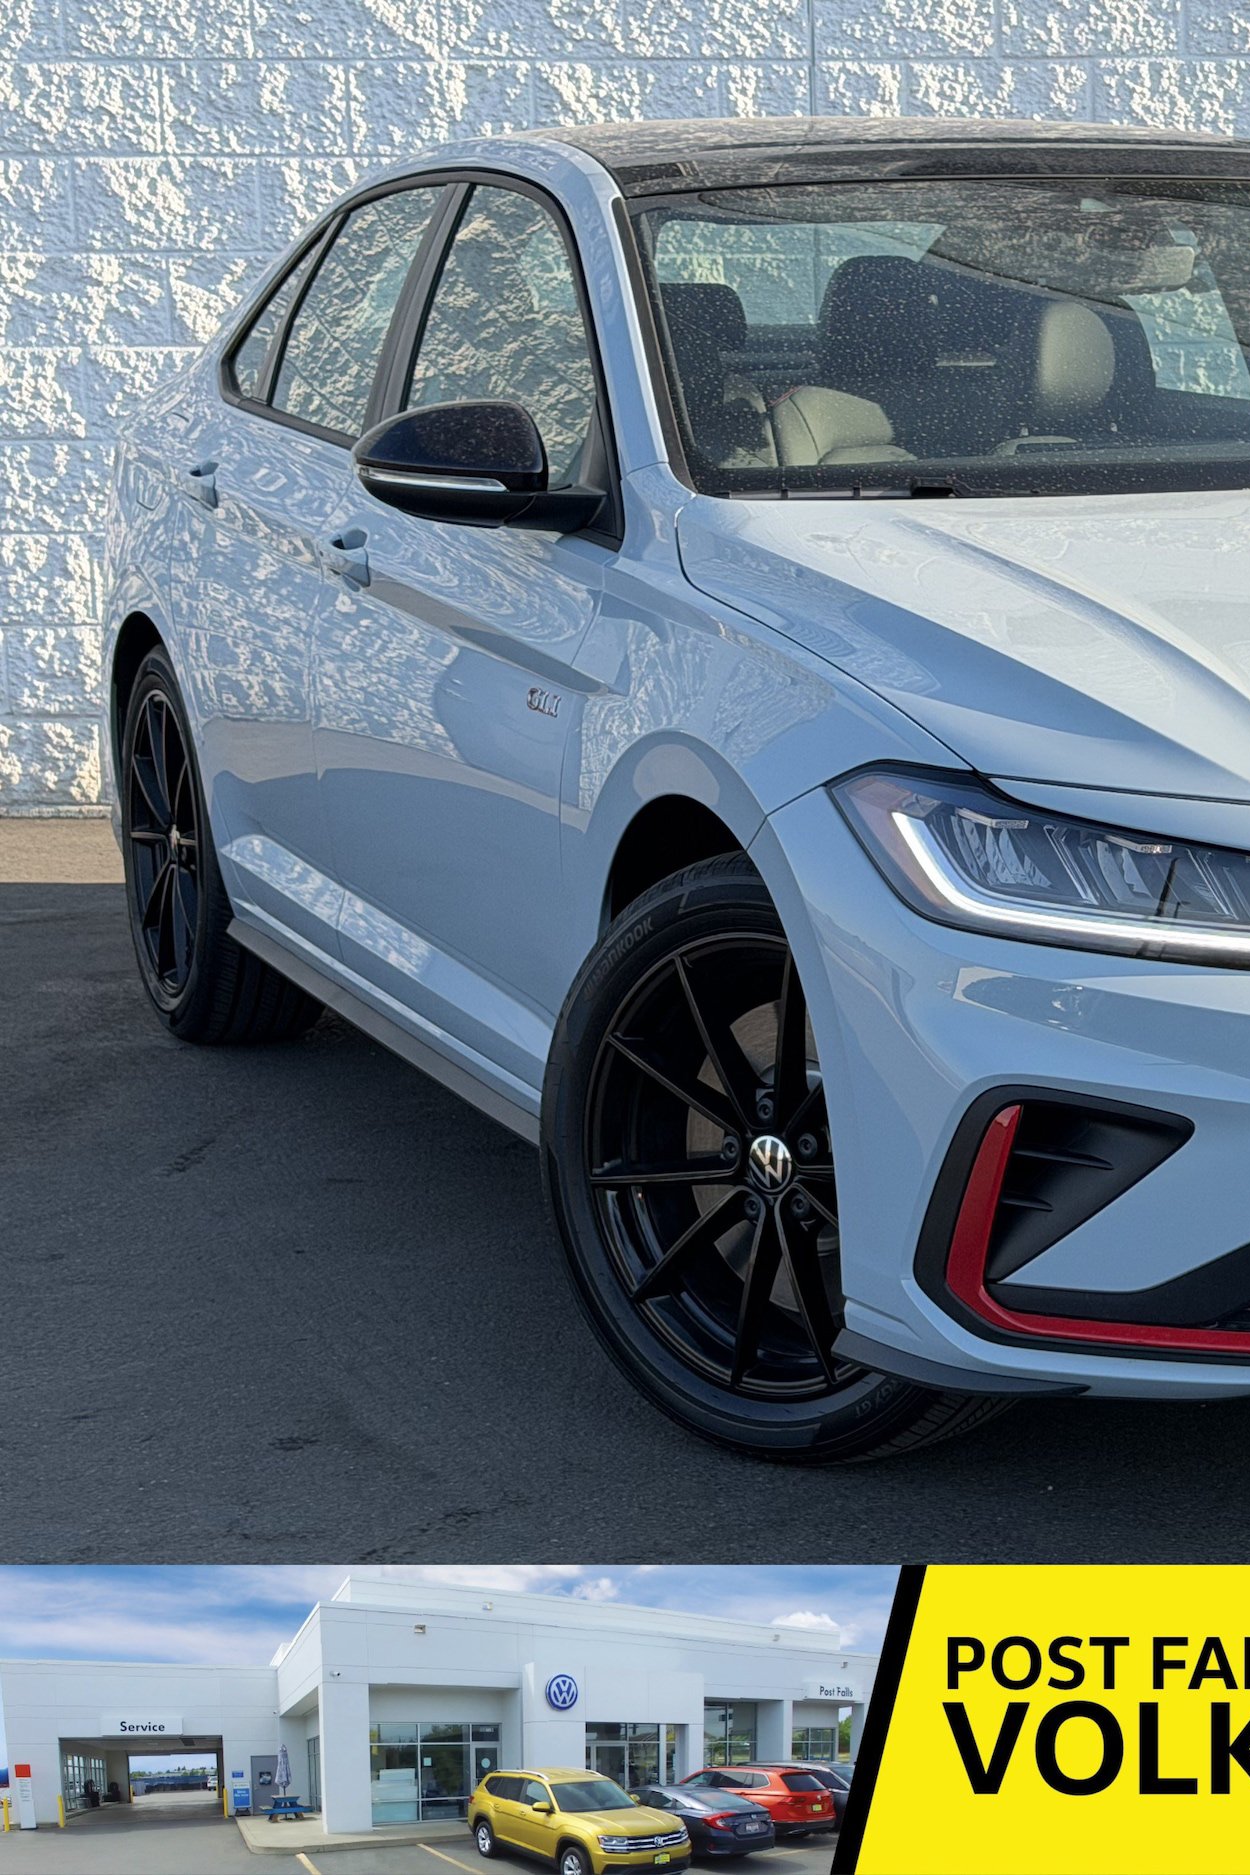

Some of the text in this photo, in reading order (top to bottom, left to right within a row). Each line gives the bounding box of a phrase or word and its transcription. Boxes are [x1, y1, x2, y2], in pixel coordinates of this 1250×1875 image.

[819, 1686, 854, 1698] Post Falls
[120, 1721, 165, 1732] Service
